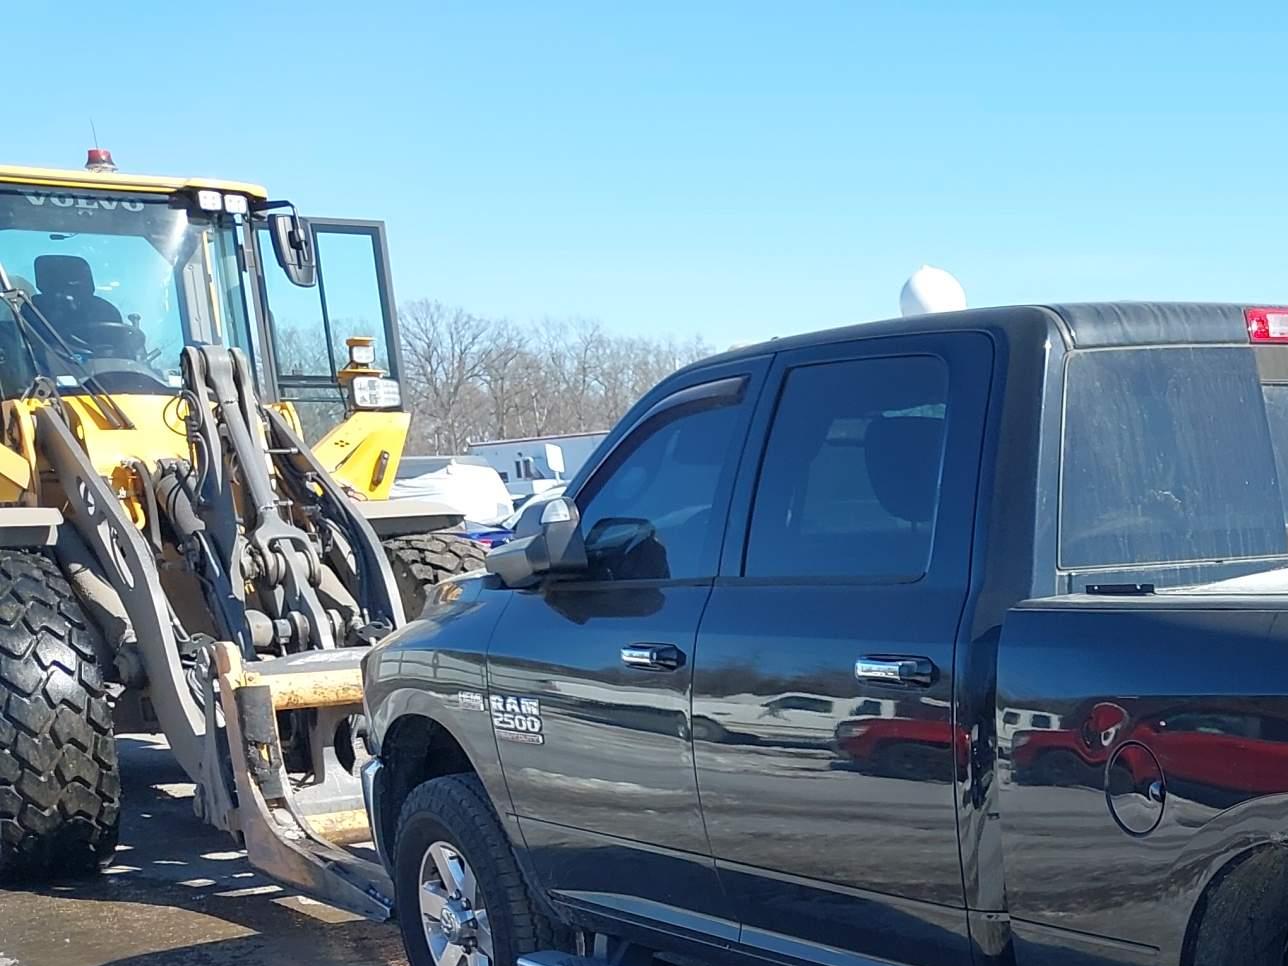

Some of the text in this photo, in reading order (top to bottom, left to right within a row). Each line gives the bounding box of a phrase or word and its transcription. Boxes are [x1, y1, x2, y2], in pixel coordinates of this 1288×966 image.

[22, 190, 145, 212] VOLVO
[489, 695, 540, 715] RAM
[493, 712, 541, 732] 2500
